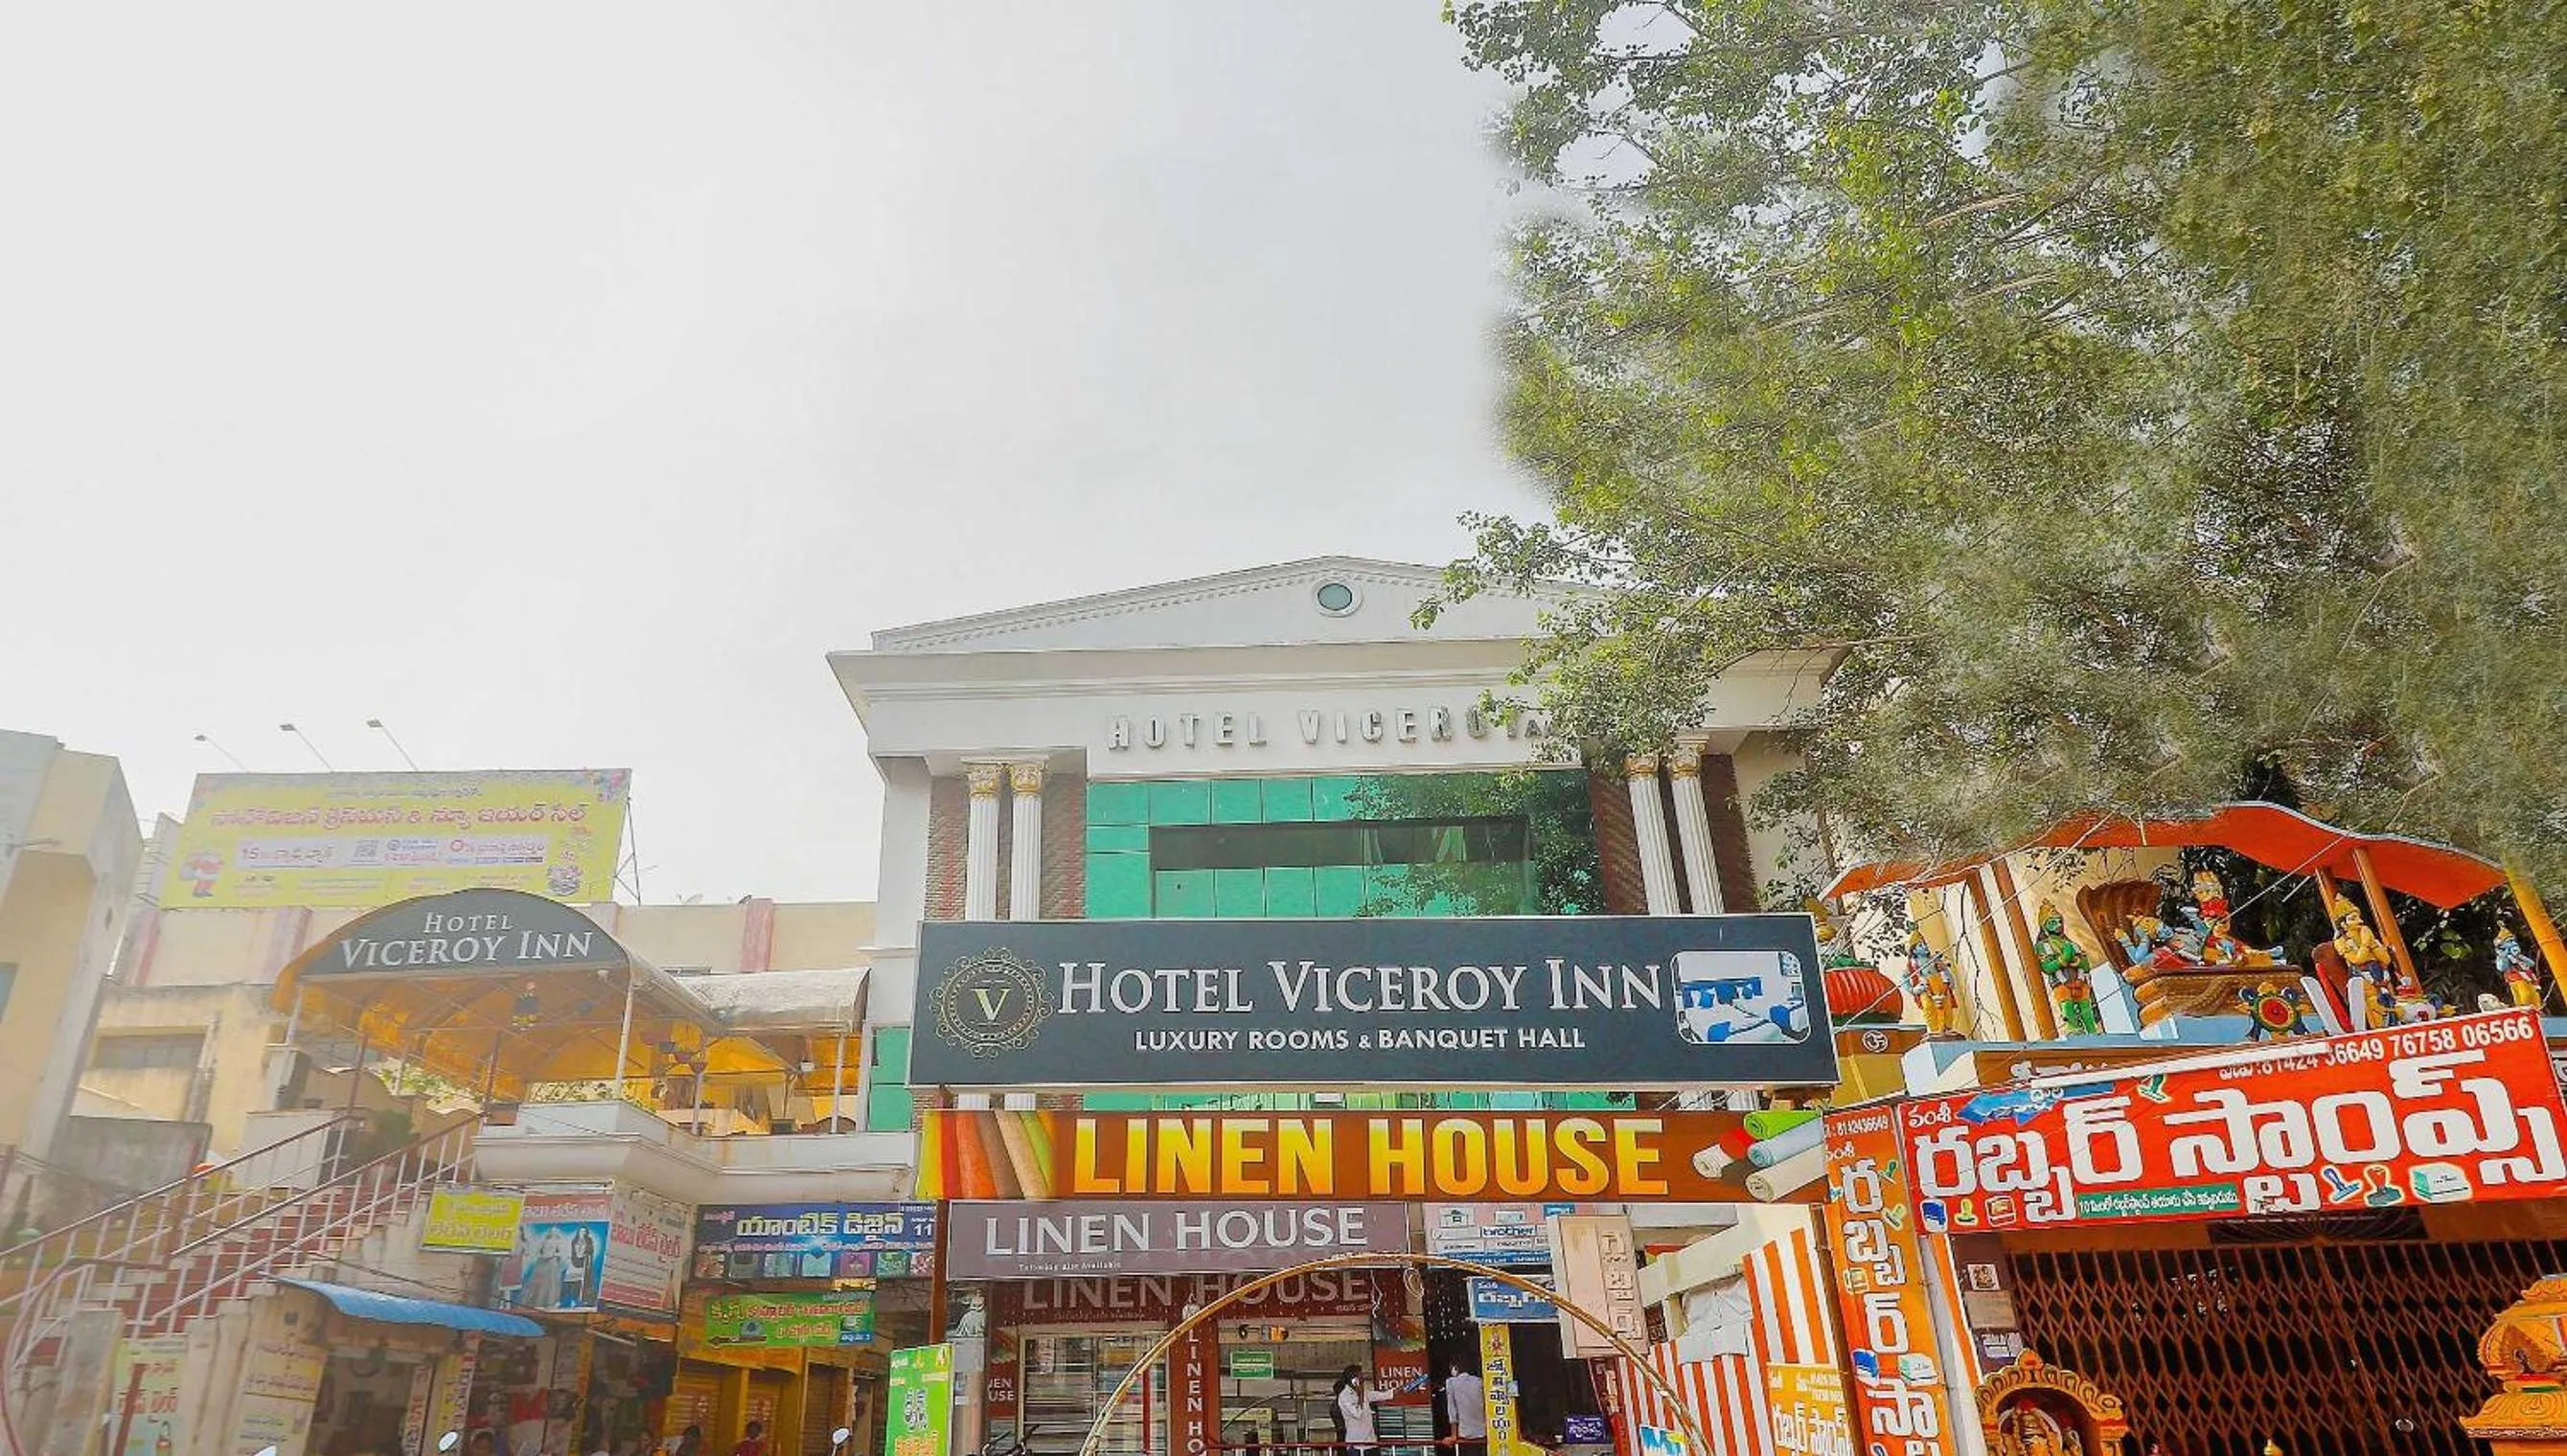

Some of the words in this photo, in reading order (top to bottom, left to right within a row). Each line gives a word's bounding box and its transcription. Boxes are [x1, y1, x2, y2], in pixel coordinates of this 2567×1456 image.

[1108, 711, 1267, 751] HOTEL
[423, 911, 515, 934] HOTEL
[339, 936, 507, 969] VICEROY
[516, 929, 593, 960] INN
[972, 988, 1012, 1022] V
[1057, 961, 1254, 1014] HOTEL
[1267, 960, 1527, 1013] VICEROY
[1545, 958, 1662, 1012] INN
[1135, 1029, 1239, 1051] LUXURY
[1249, 1029, 1350, 1051] ROOMS
[1358, 1033, 1371, 1050] &
[1378, 1028, 1508, 1050] BANQUET
[1518, 1028, 1586, 1050] HALL
[2389, 1028, 2455, 1058] 76758
[2461, 1017, 2533, 1047] 06566
[1074, 1117, 1335, 1196] LINEN
[1367, 1116, 1670, 1197] HOUSE
[1915, 1096, 2143, 1222] రబ్బర్
[984, 1211, 1151, 1256] LINEN
[1174, 1206, 1368, 1251] HOUSE
[1482, 1226, 1535, 1237] brother
[1023, 1275, 1172, 1310] LINEN
[1194, 1270, 1373, 1308] HOUSE
[1186, 1329, 1203, 1413] LINEN
[1380, 1366, 1423, 1378] LINEN
[988, 1391, 1016, 1402] USE
